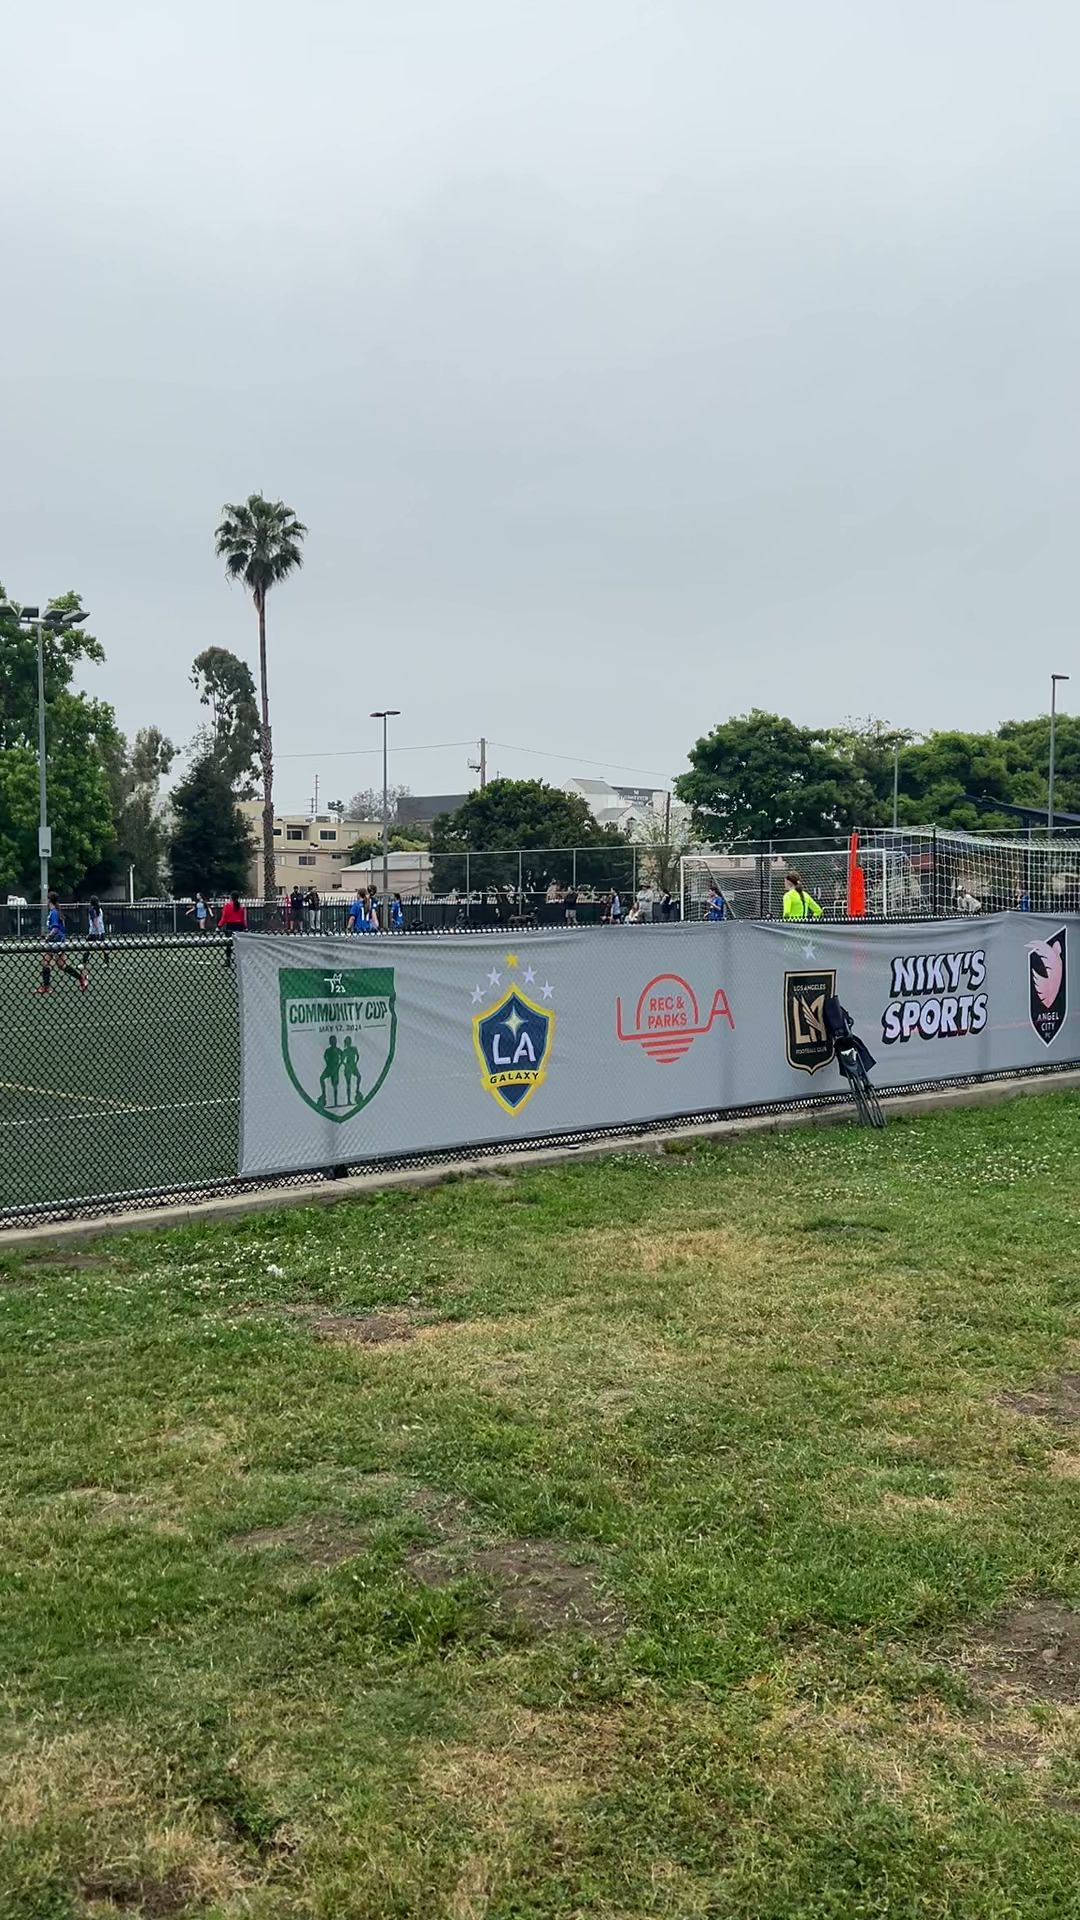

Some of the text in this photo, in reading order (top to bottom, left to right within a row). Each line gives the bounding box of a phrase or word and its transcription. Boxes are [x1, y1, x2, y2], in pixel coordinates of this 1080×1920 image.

[890, 950, 986, 998] NIKY'S
[649, 995, 685, 1011] REC &
[289, 1001, 388, 1024] COMMUNITY CUP
[881, 993, 988, 1045] SPORTS
[1037, 1011, 1060, 1021] ANGEL
[648, 1013, 688, 1029] PARKS
[1040, 1022, 1055, 1031] CITY
[493, 1032, 536, 1065] LA
[490, 1072, 539, 1084] GALAXY
